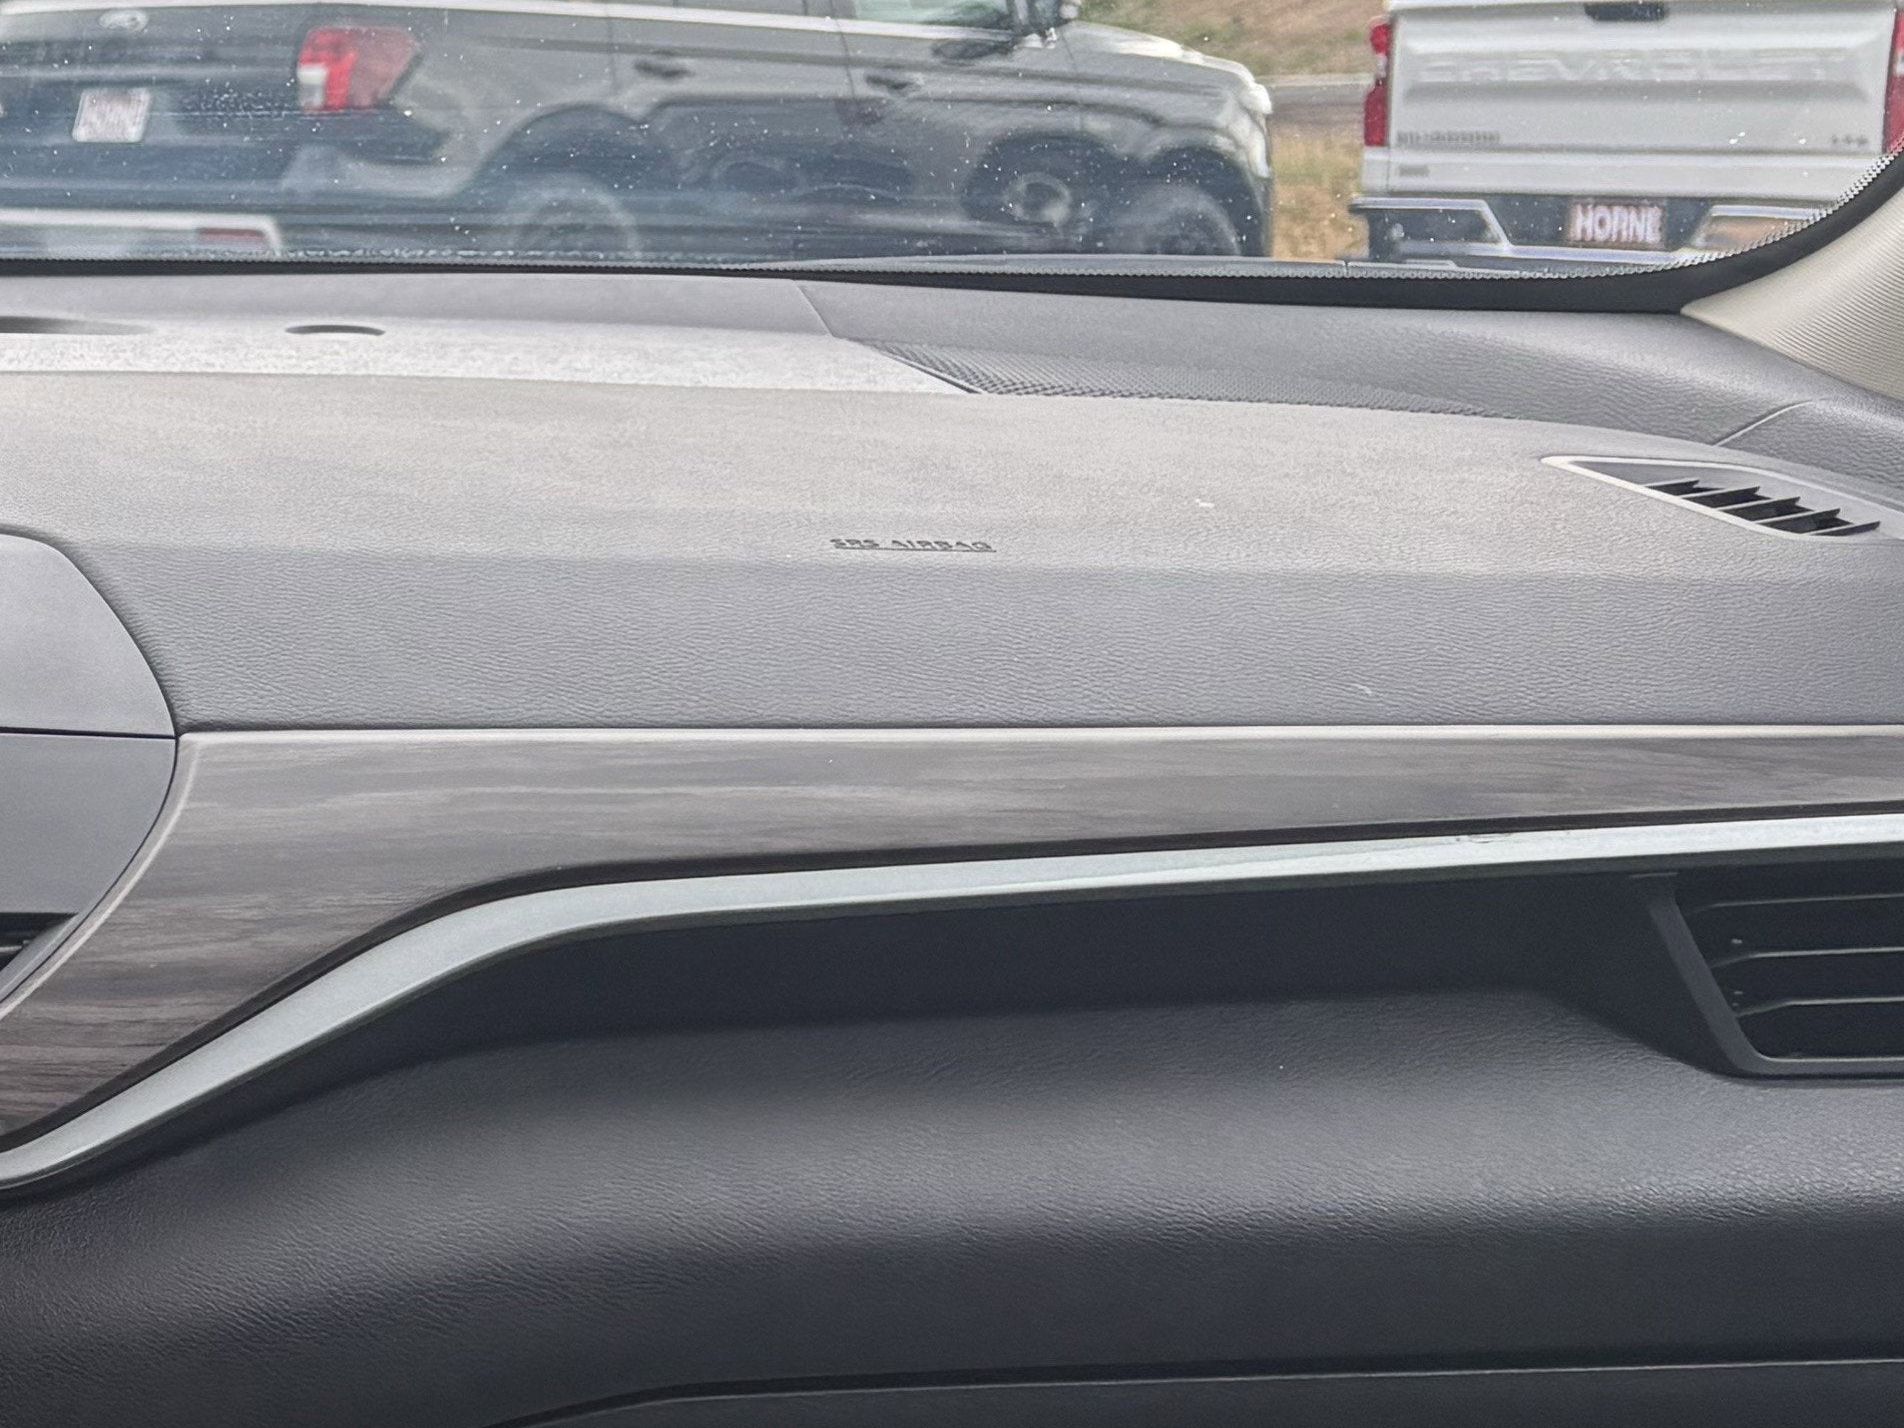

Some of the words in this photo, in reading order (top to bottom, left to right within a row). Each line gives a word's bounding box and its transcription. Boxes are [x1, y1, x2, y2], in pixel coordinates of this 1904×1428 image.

[1573, 203, 1663, 243] HORNE
[830, 538, 880, 549] SRS
[892, 539, 994, 551] AIRBAG
